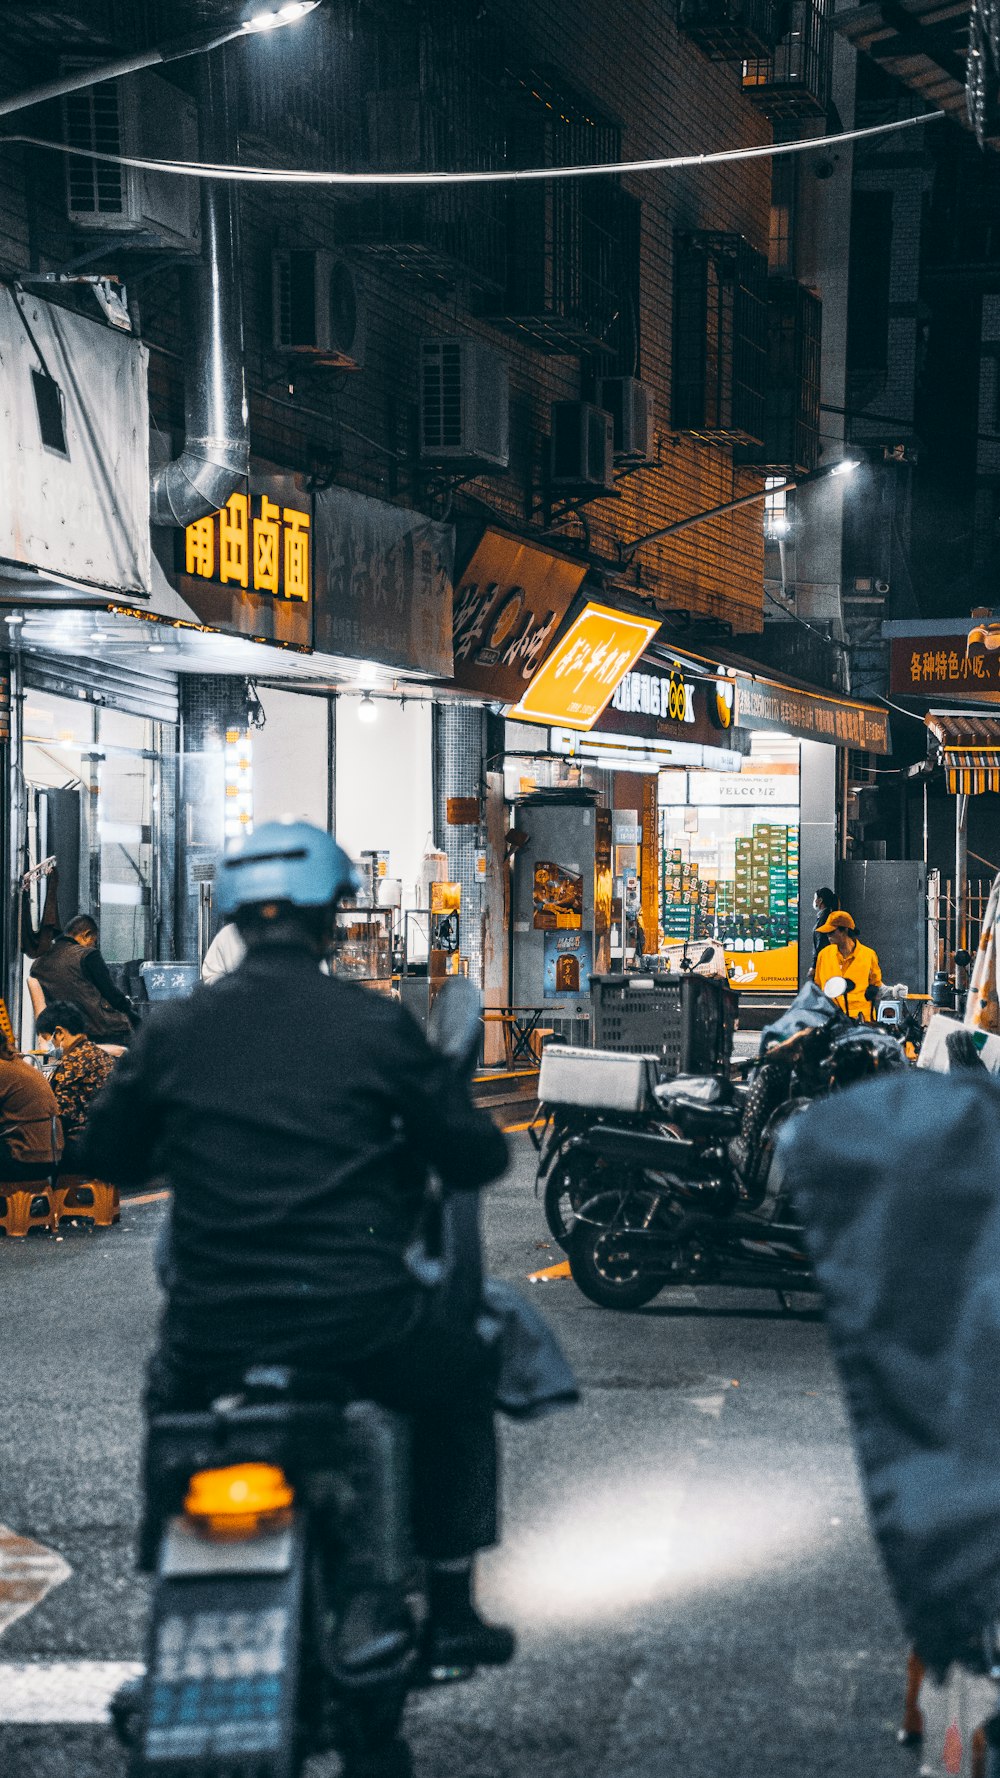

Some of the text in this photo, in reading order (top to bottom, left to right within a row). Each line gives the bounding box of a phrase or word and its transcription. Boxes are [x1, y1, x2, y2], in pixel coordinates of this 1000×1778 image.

[910, 650, 1000, 681] 各种特色小吃、
